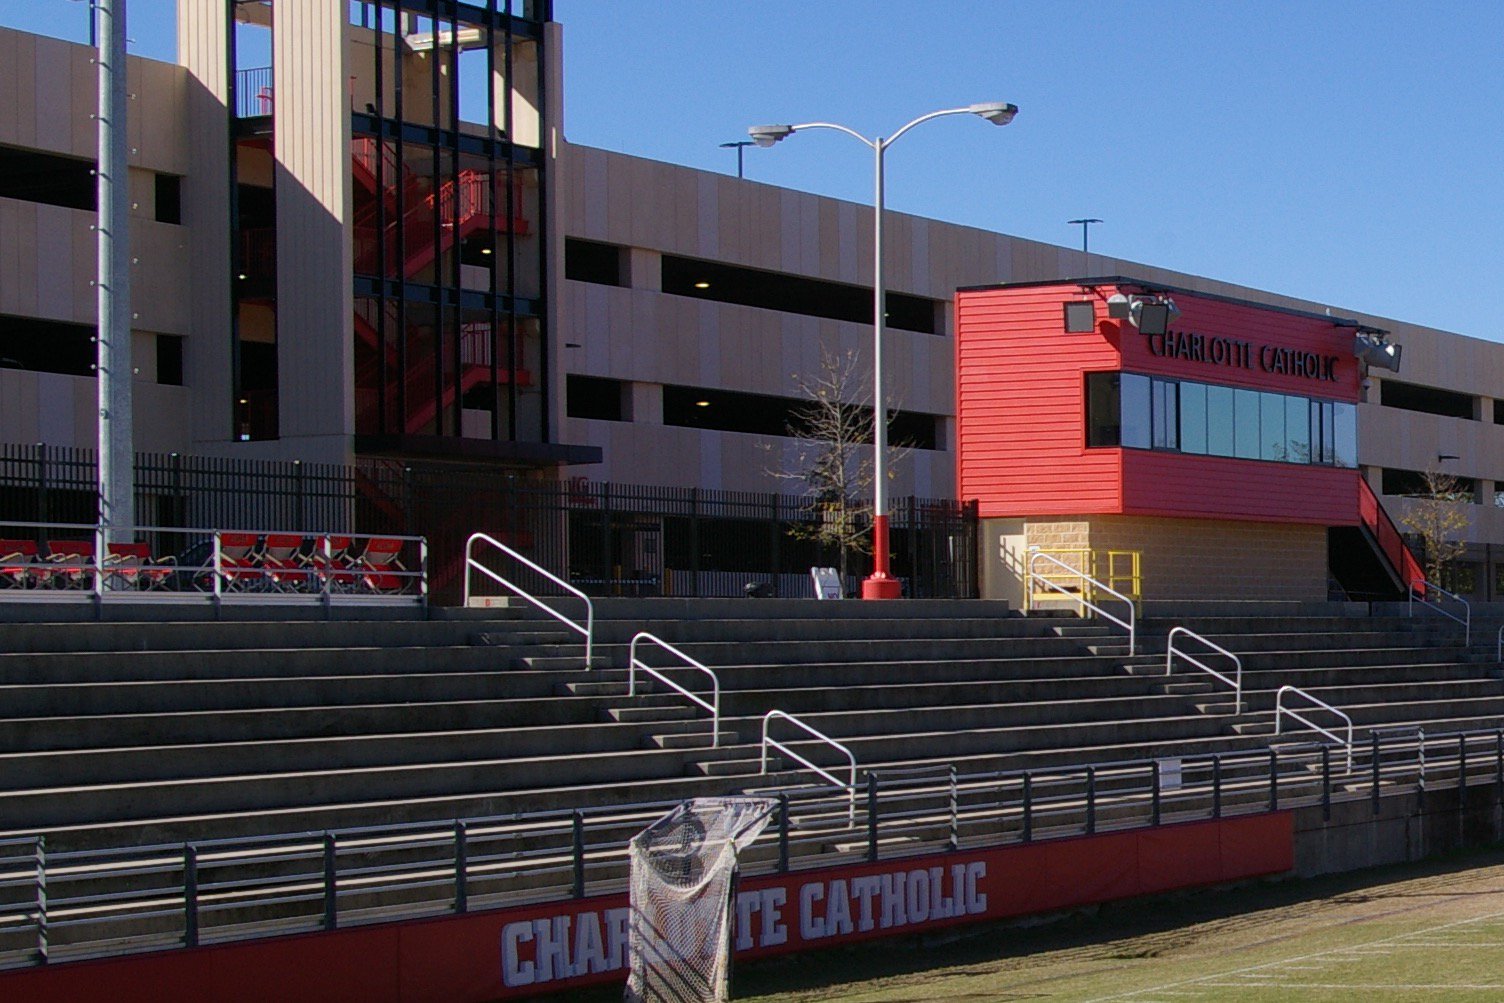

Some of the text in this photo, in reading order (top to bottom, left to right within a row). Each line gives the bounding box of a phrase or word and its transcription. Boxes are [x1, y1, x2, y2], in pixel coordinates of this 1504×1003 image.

[1150, 330, 1339, 381] CHARLOTTE CATHOLIC
[800, 861, 987, 941] CATHOLIC
